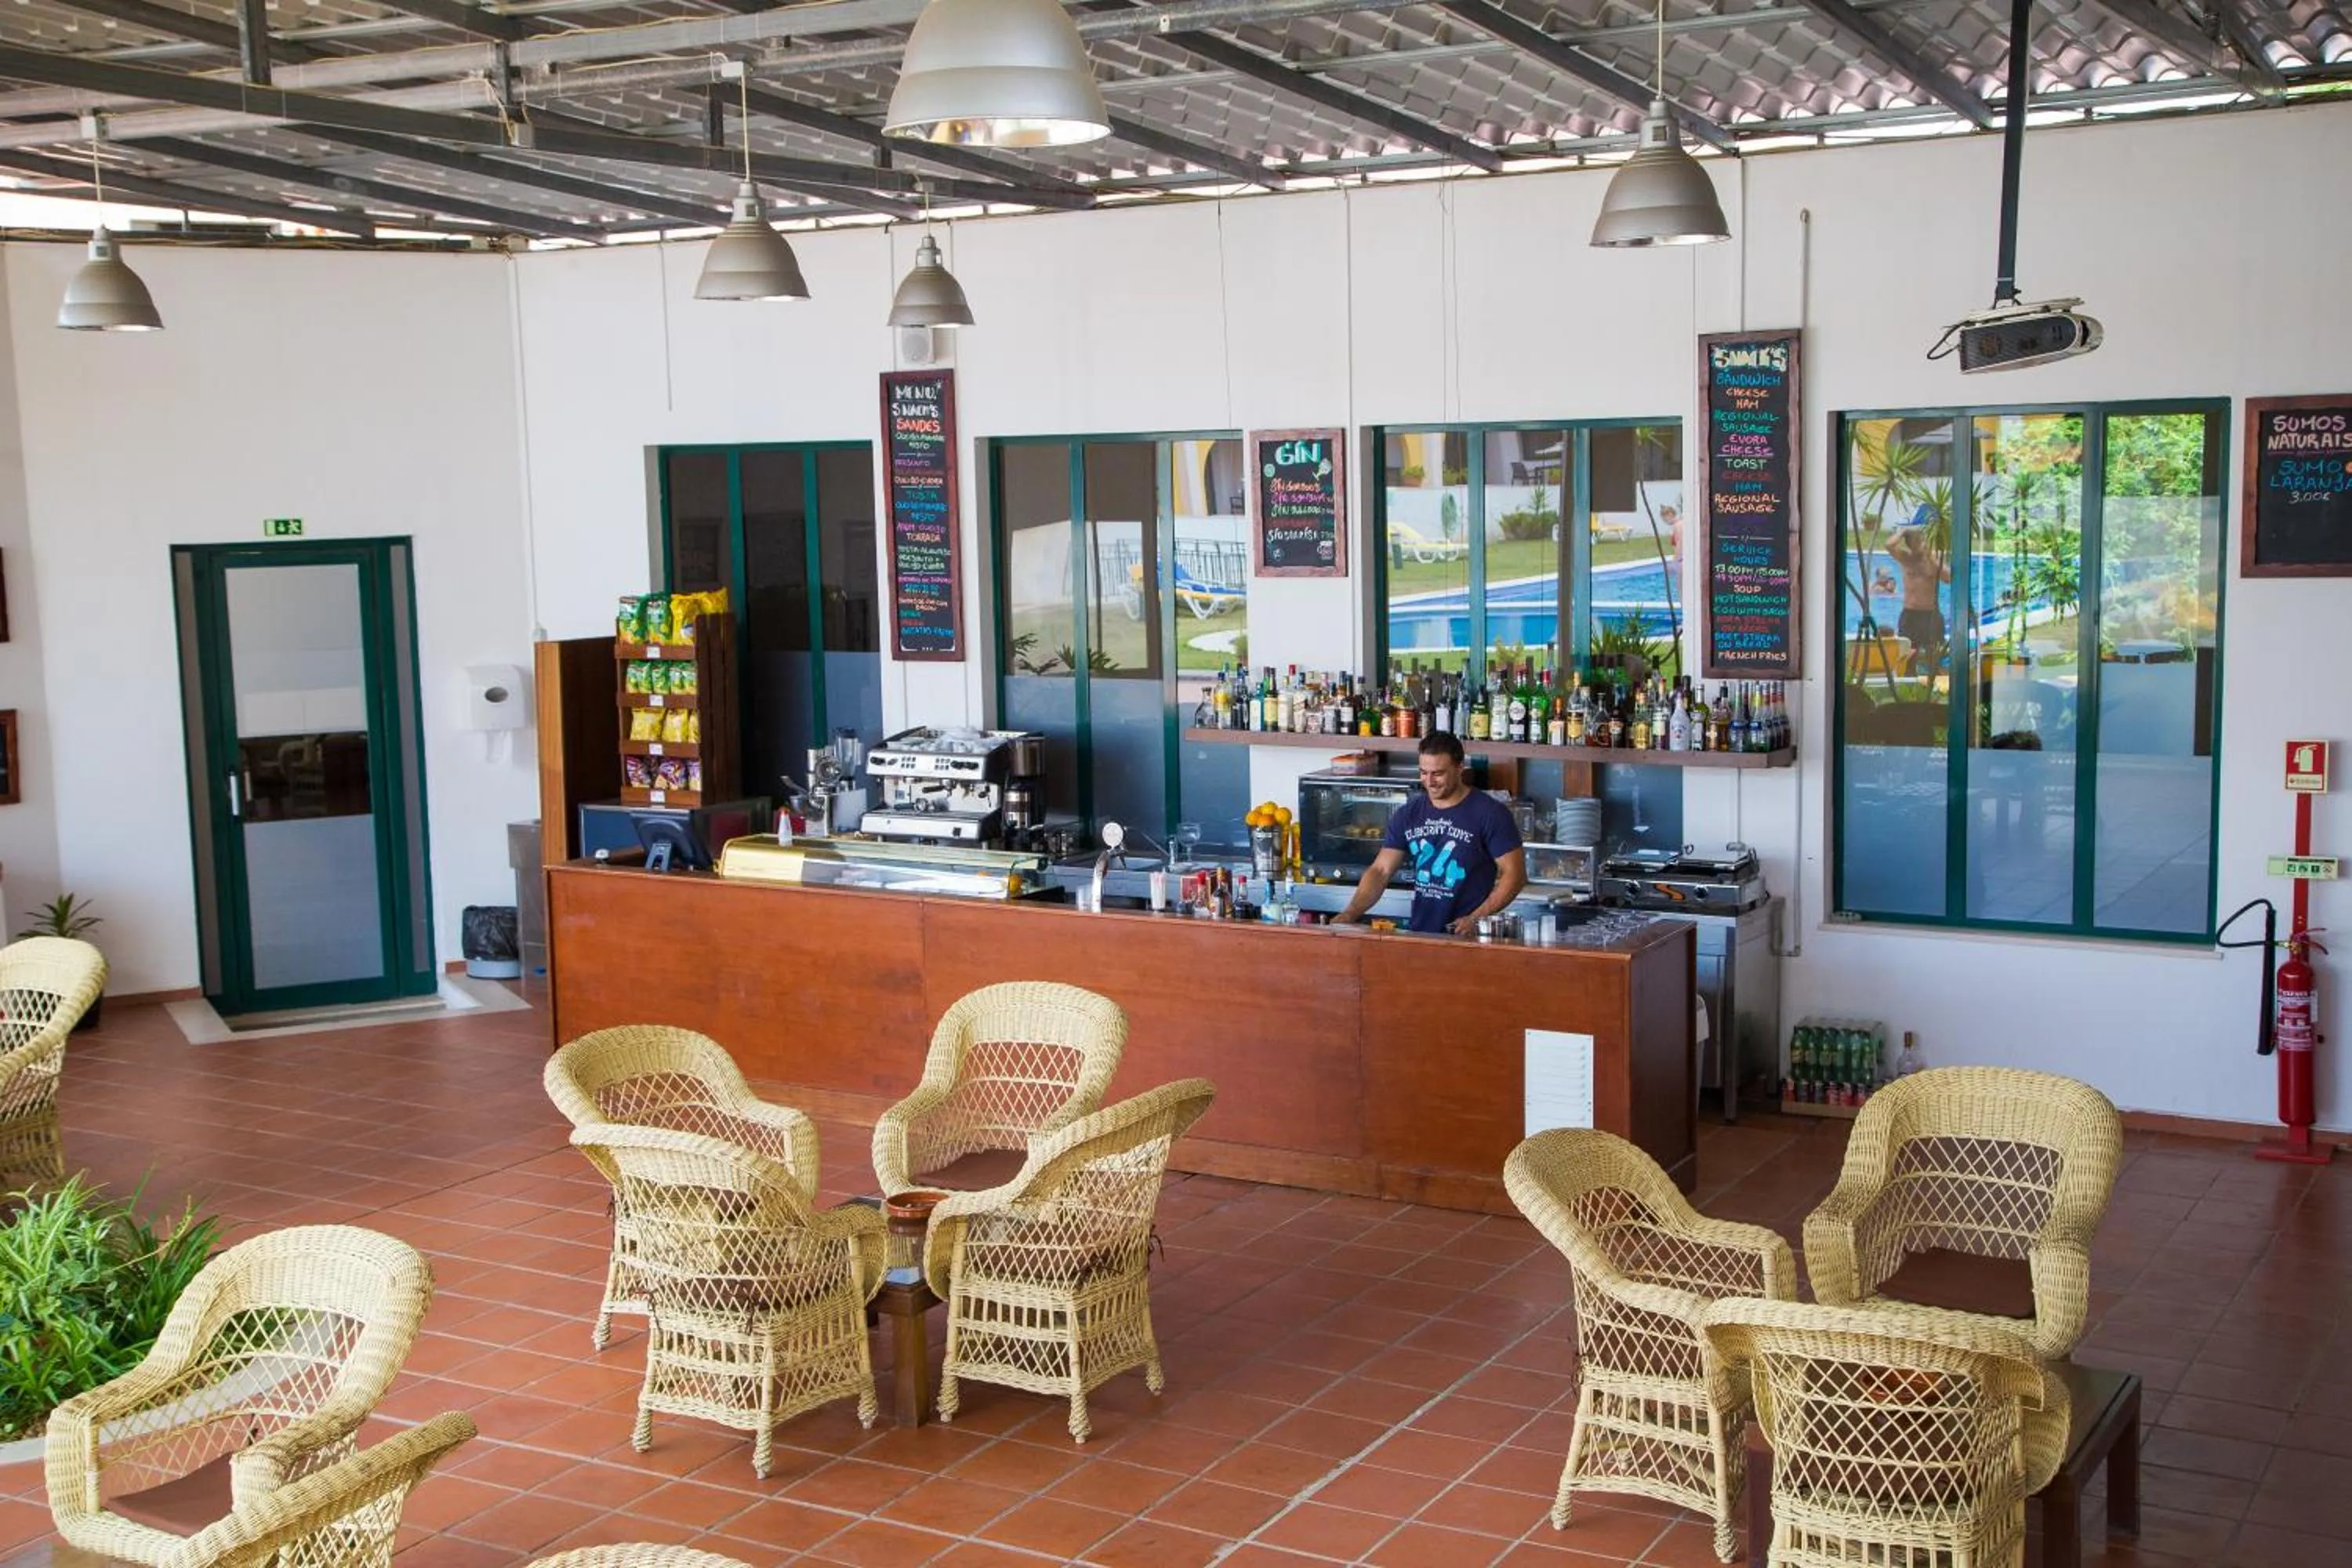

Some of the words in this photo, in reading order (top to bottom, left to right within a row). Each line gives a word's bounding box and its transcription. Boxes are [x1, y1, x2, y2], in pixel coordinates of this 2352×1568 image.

[1716, 374, 1781, 386] SANDWICH
[1726, 387, 1769, 397] CHEESE
[896, 419, 941, 434] SANDES
[2274, 415, 2347, 432] SUMOS
[2267, 433, 2352, 449] NATURAIS
[1275, 441, 1321, 465] GIN
[1725, 458, 1767, 470] TOAST
[2278, 459, 2342, 475] SUMO
[1715, 493, 1780, 503] REGIONAL
[1717, 503, 1775, 514] SAUSAGE
[1733, 584, 1762, 593] SOUP
